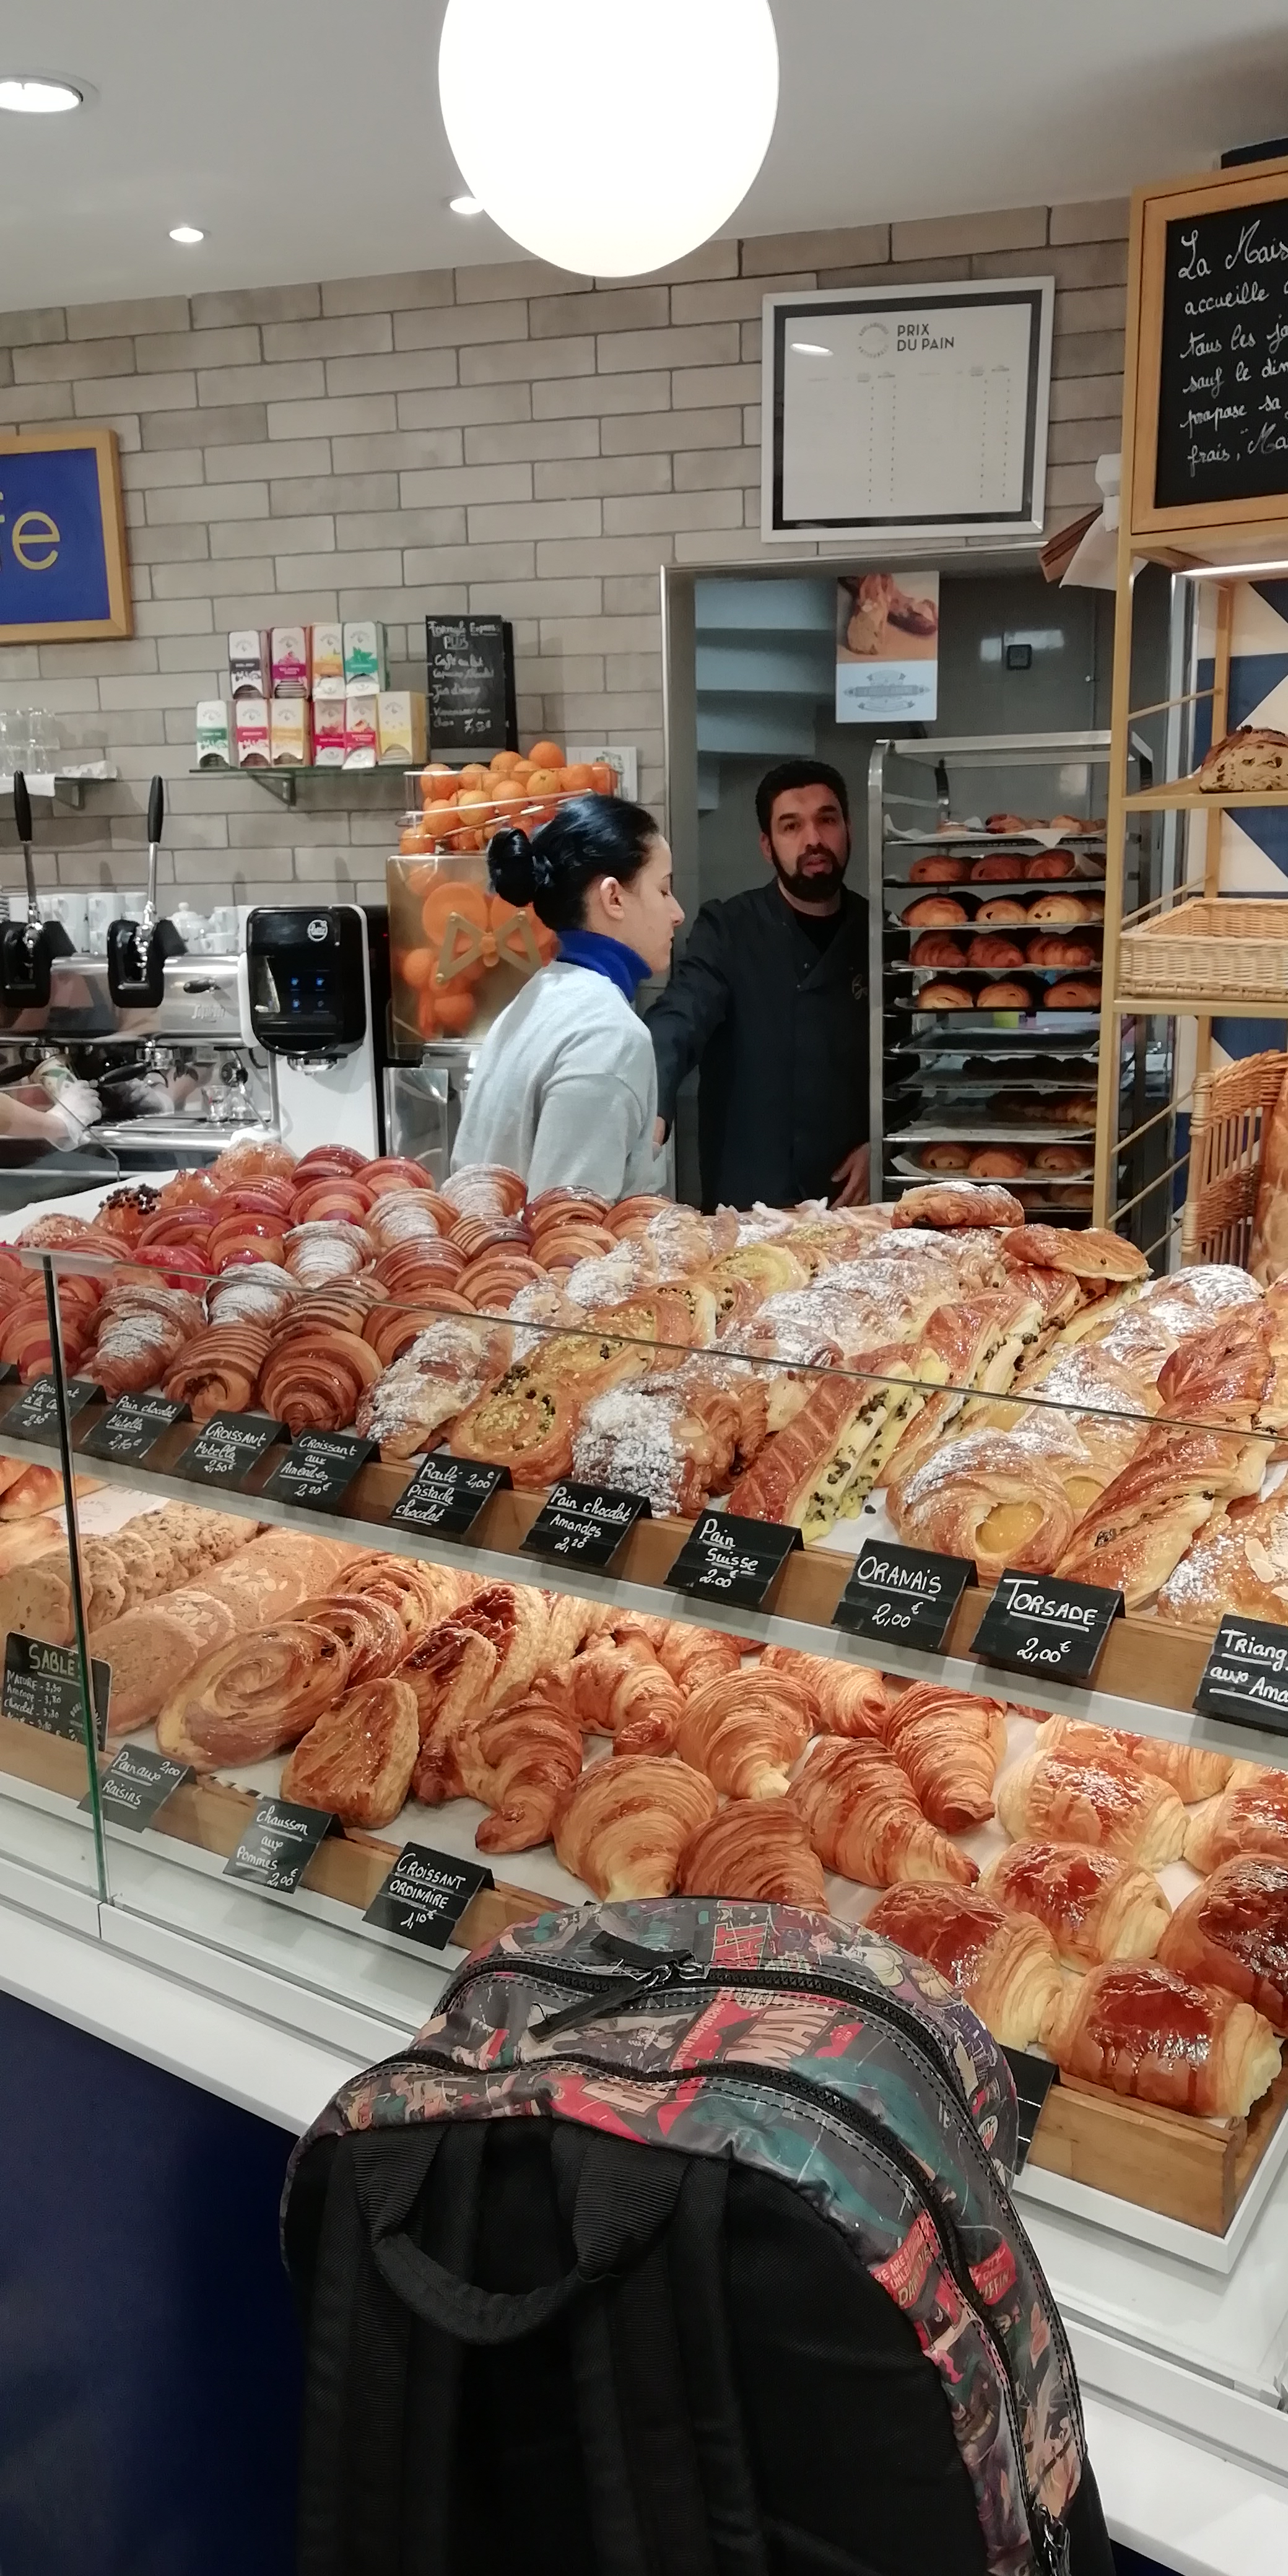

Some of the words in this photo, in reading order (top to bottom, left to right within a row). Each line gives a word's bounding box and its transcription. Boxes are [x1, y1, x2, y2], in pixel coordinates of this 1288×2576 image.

[1178, 229, 1212, 280] La
[1185, 281, 1270, 315] accueille
[897, 323, 930, 337] PRIX
[1230, 323, 1256, 351] les
[897, 339, 918, 352] DU
[921, 336, 955, 350] PAIN
[1182, 366, 1225, 399] sauf
[1235, 360, 1252, 381] le
[1258, 394, 1282, 412] sa
[116, 1395, 137, 1411] Pain
[141, 1400, 178, 1418] chocolat
[107, 1414, 143, 1431] Nutella
[194, 1441, 237, 1462] Nutella
[305, 1454, 327, 1466] aux
[395, 1502, 443, 1522] chocolat
[550, 1487, 578, 1509] Pain
[583, 1496, 633, 1522] chocolat
[549, 1513, 602, 1538] Amandes
[698, 1518, 736, 1548] Pain
[705, 1548, 759, 1572] Suisse
[1003, 1577, 1099, 1626] TORSADE
[1209, 1666, 1250, 1684] aux
[102, 1779, 142, 1806] Raisins
[261, 1834, 284, 1852] aux
[235, 1846, 278, 1871] Pommes
[396, 1852, 466, 1891] CROISSANT
[389, 1879, 450, 1909] ORDINAIRE
